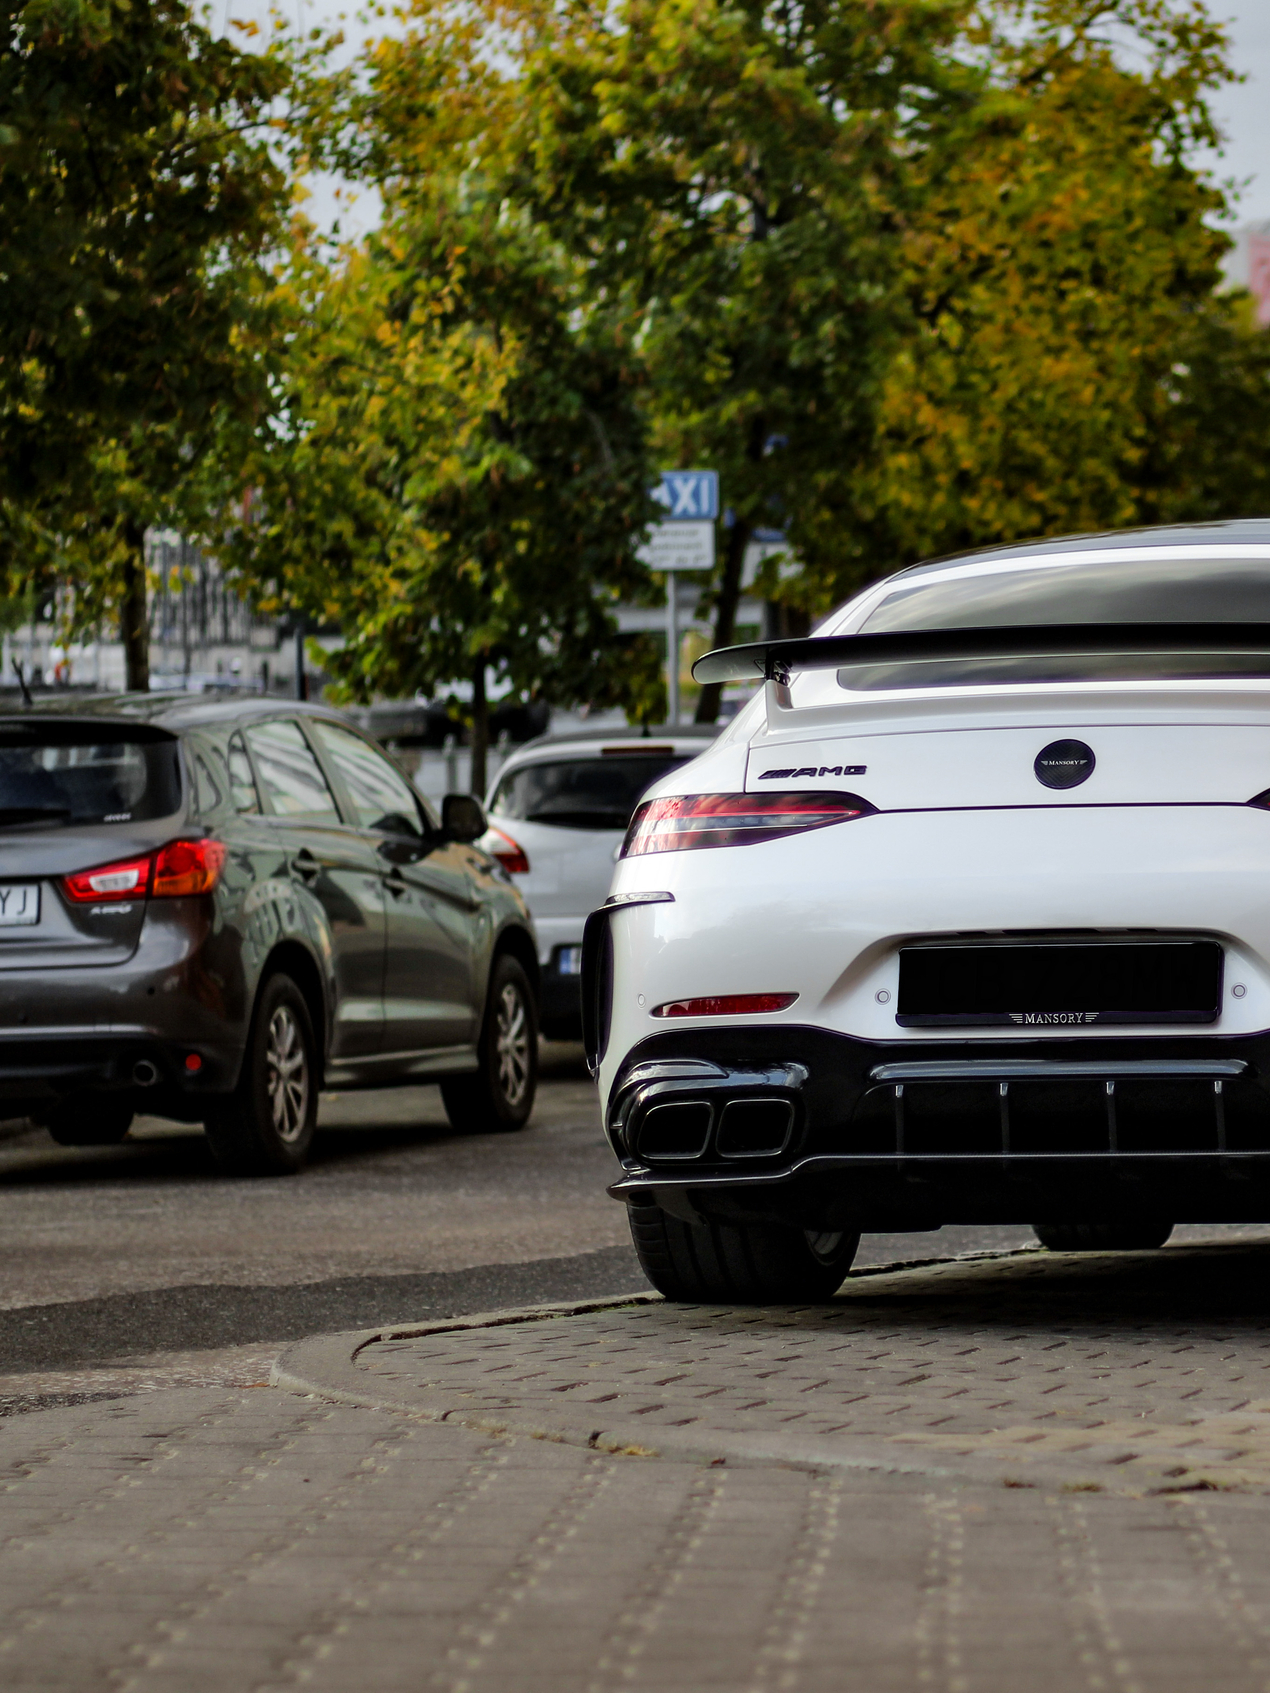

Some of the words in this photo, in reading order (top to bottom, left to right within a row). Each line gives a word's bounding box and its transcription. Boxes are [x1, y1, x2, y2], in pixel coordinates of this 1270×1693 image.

[650, 478, 711, 516] AXI
[791, 765, 868, 778] AMG
[1025, 1012, 1084, 1024] MANSORY
